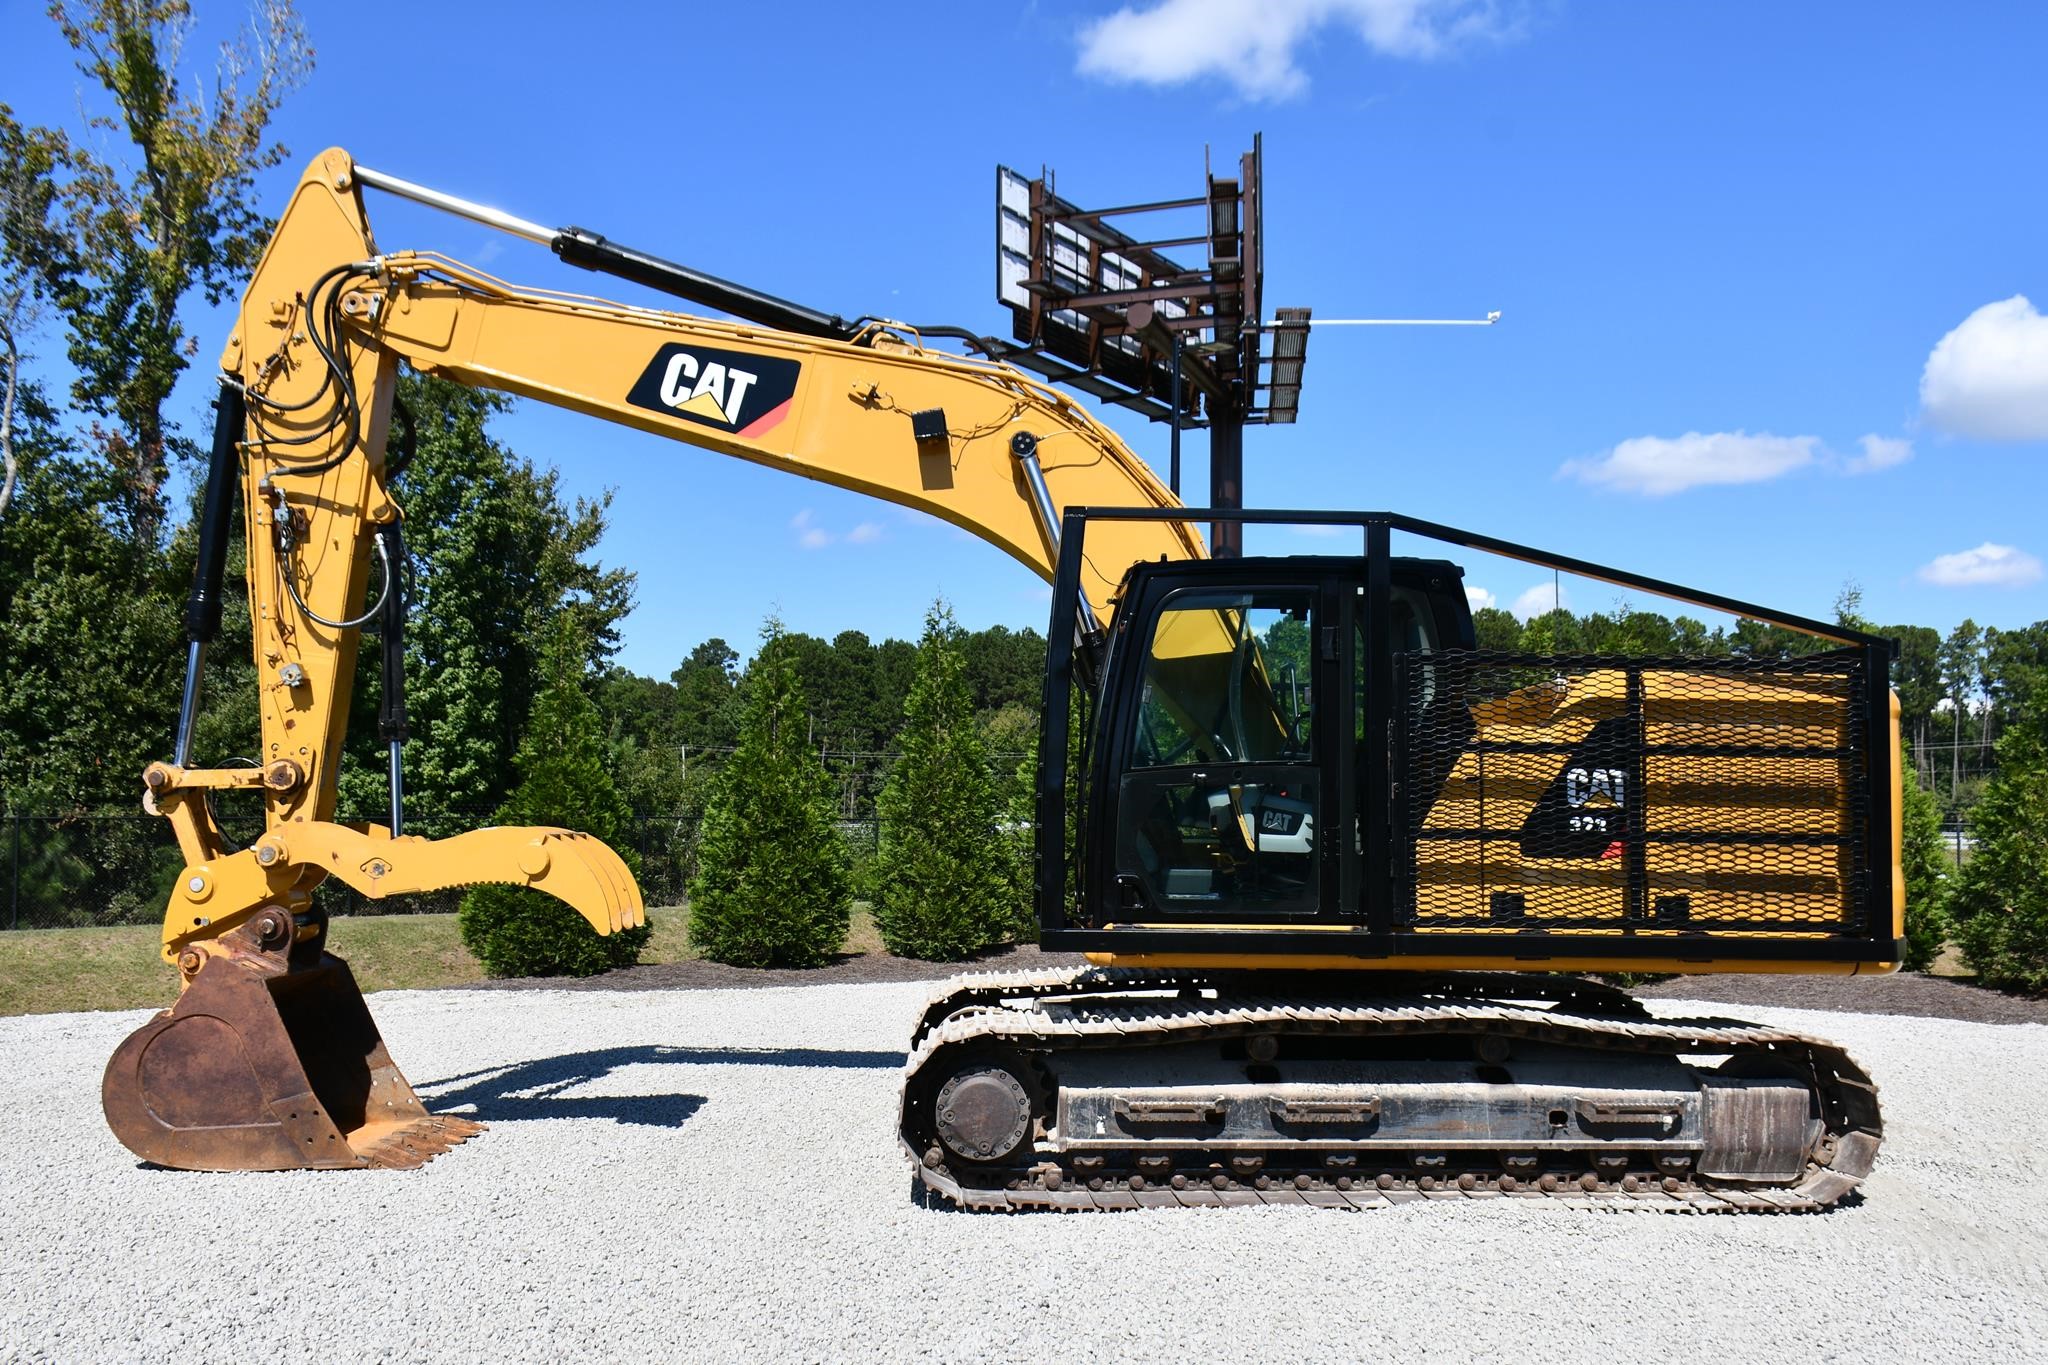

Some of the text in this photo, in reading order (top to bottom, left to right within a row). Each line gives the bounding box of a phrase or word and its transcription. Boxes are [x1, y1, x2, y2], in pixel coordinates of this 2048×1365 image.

[660, 352, 758, 425] CAT
[1566, 768, 1625, 808] CAT
[1262, 810, 1293, 832] CAT
